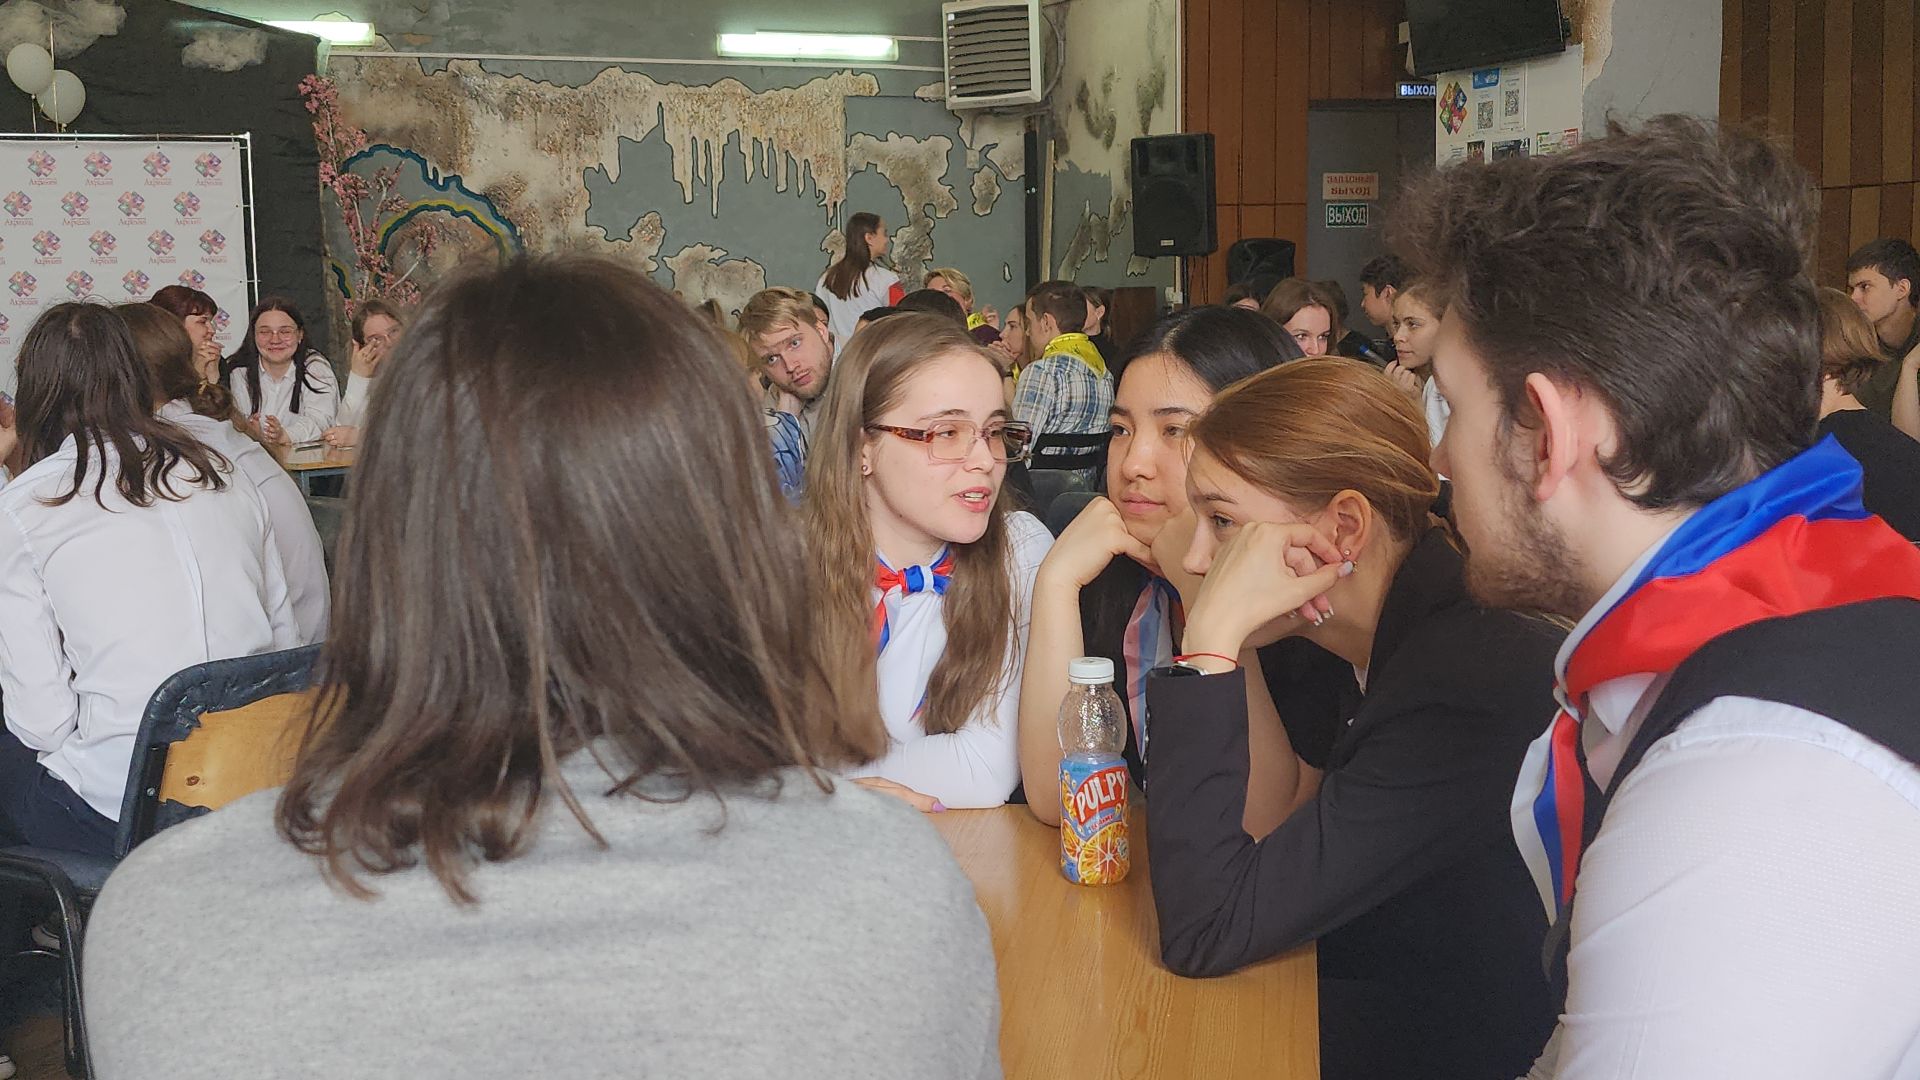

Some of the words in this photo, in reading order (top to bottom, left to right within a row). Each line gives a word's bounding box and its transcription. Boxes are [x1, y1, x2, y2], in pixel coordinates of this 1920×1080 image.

[1401, 84, 1436, 96] ВЫХОД
[1331, 187, 1370, 196] ВЫХОД
[1328, 207, 1367, 223] ВЫХОД
[1076, 771, 1126, 822] PULPY
